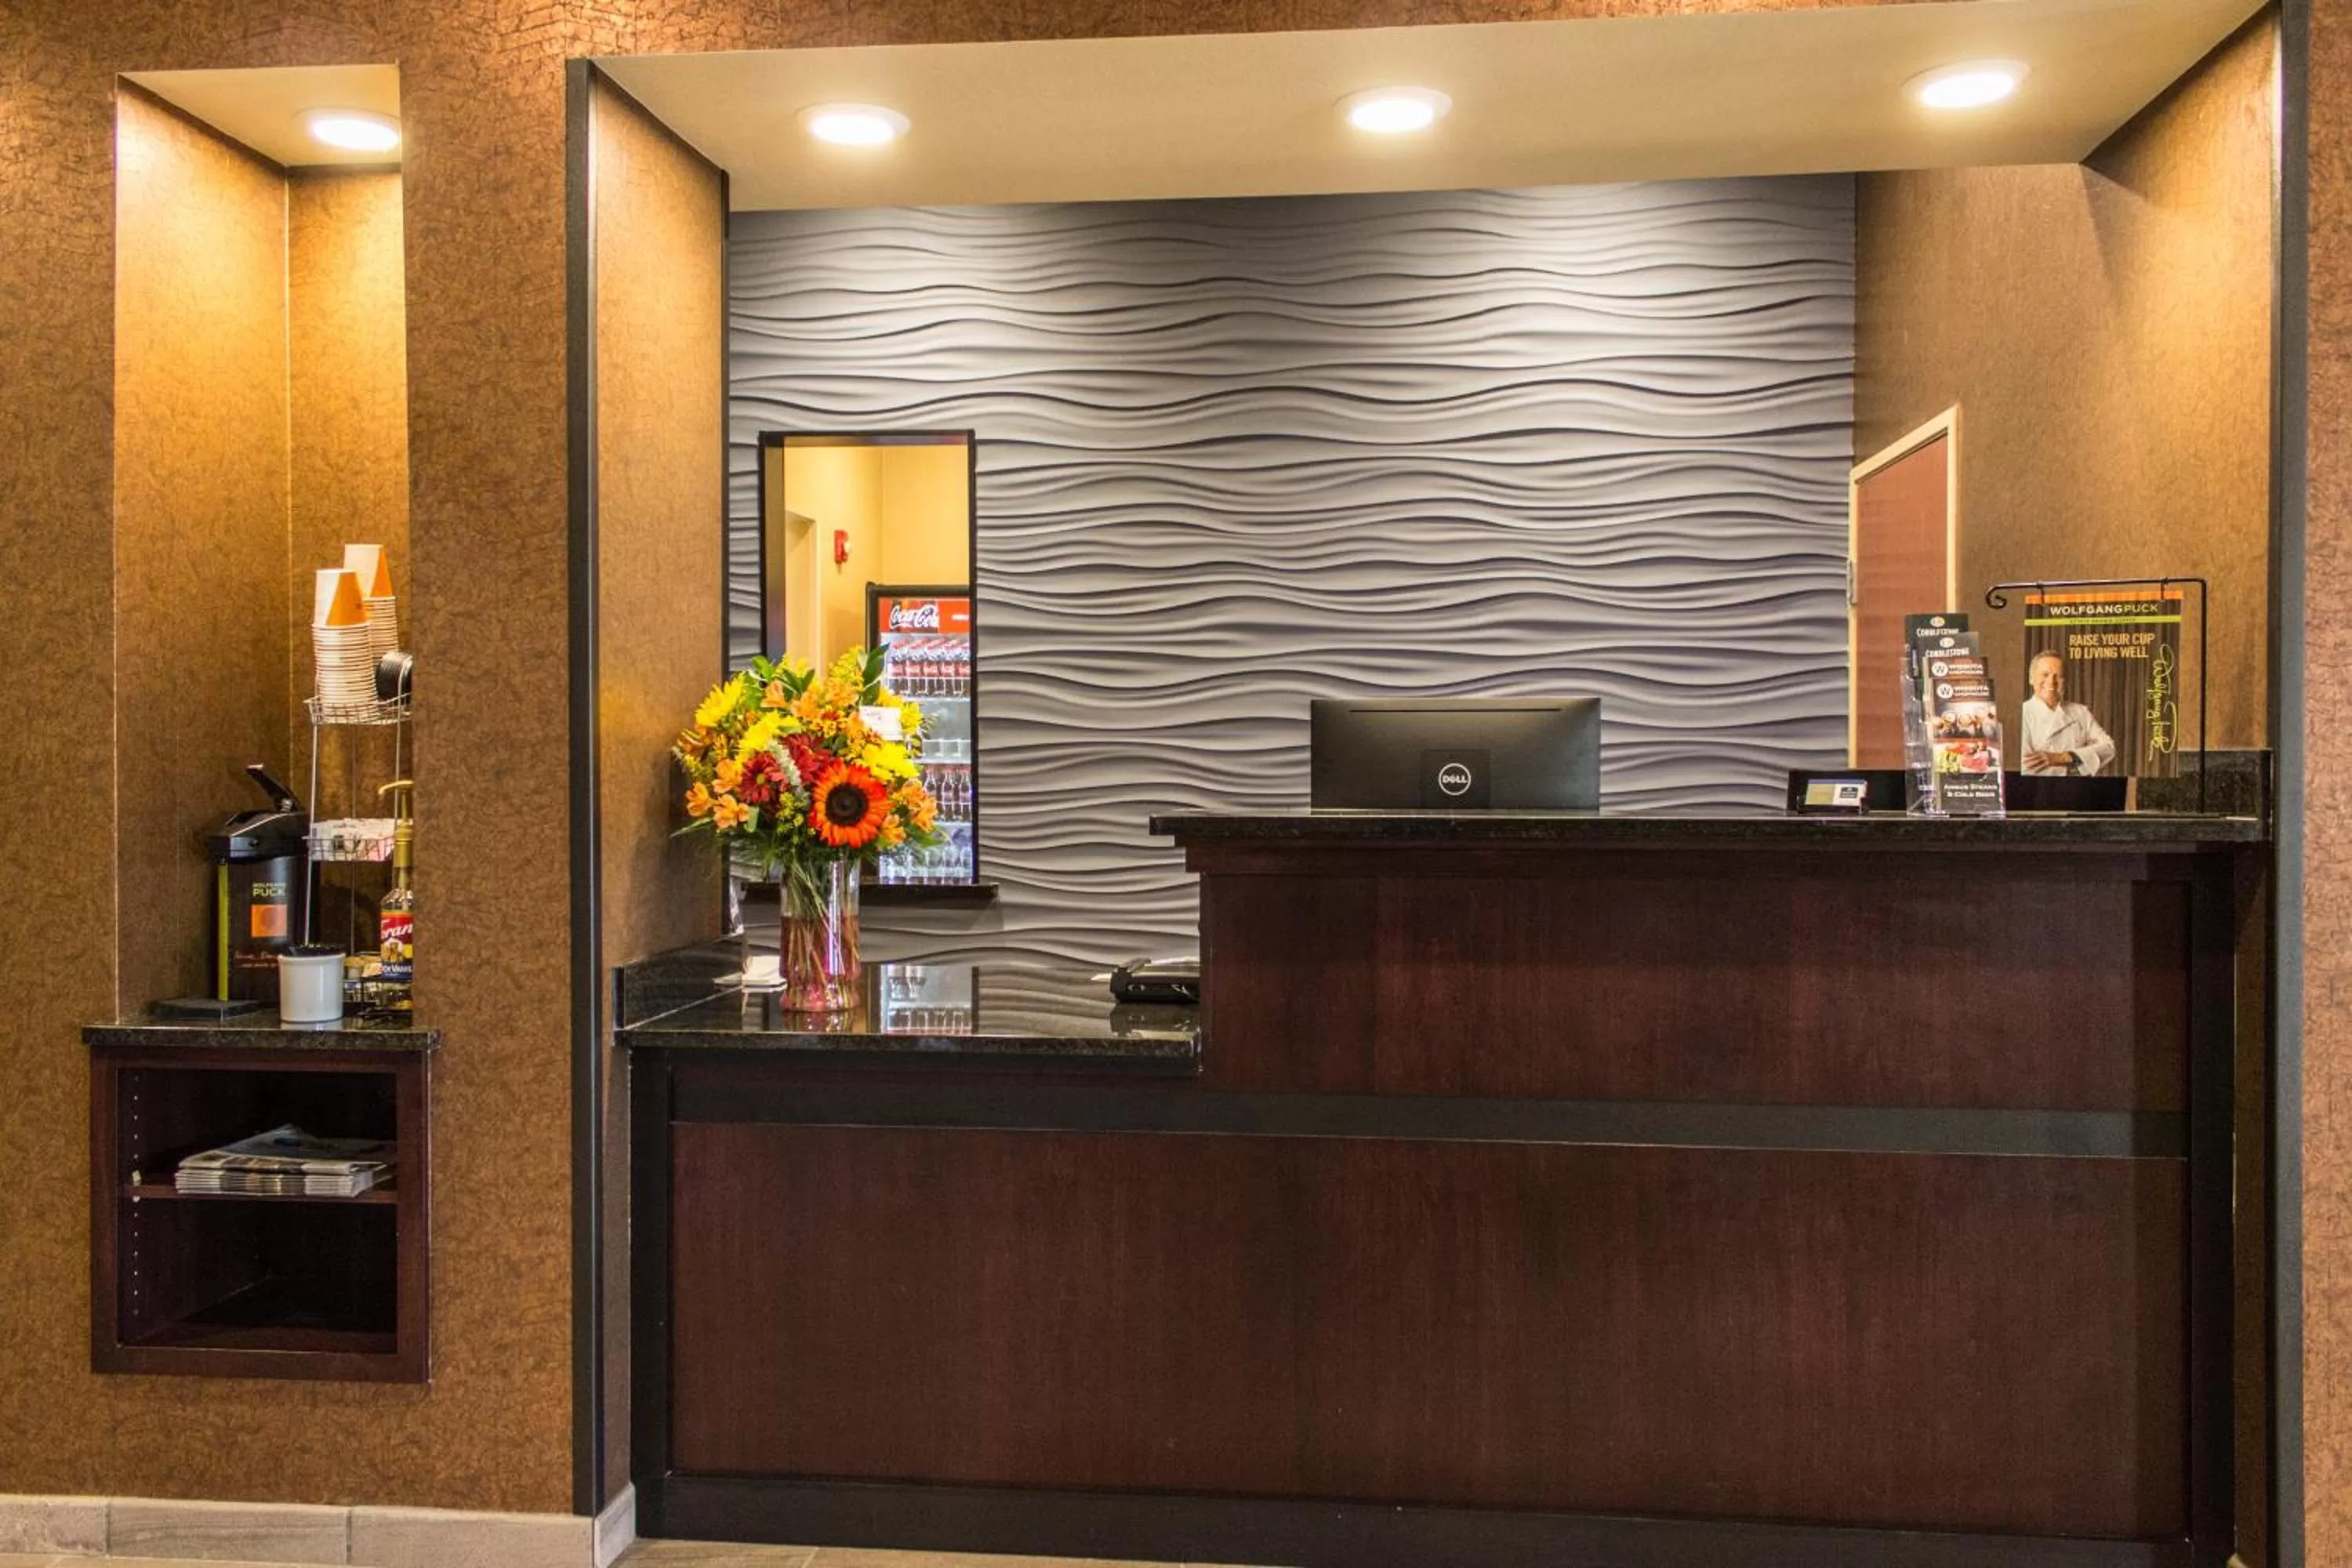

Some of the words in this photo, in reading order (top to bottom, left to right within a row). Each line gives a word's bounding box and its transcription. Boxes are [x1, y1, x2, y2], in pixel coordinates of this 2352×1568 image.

[2069, 633, 2100, 646] RAISE
[2100, 633, 2130, 645] YOUR
[2132, 632, 2156, 645] CUP
[2069, 647, 2080, 659] TO
[2084, 646, 2118, 659] LIVING
[2119, 645, 2149, 659] WELL
[1442, 774, 1468, 783] DELL
[252, 887, 286, 897] PUCK
